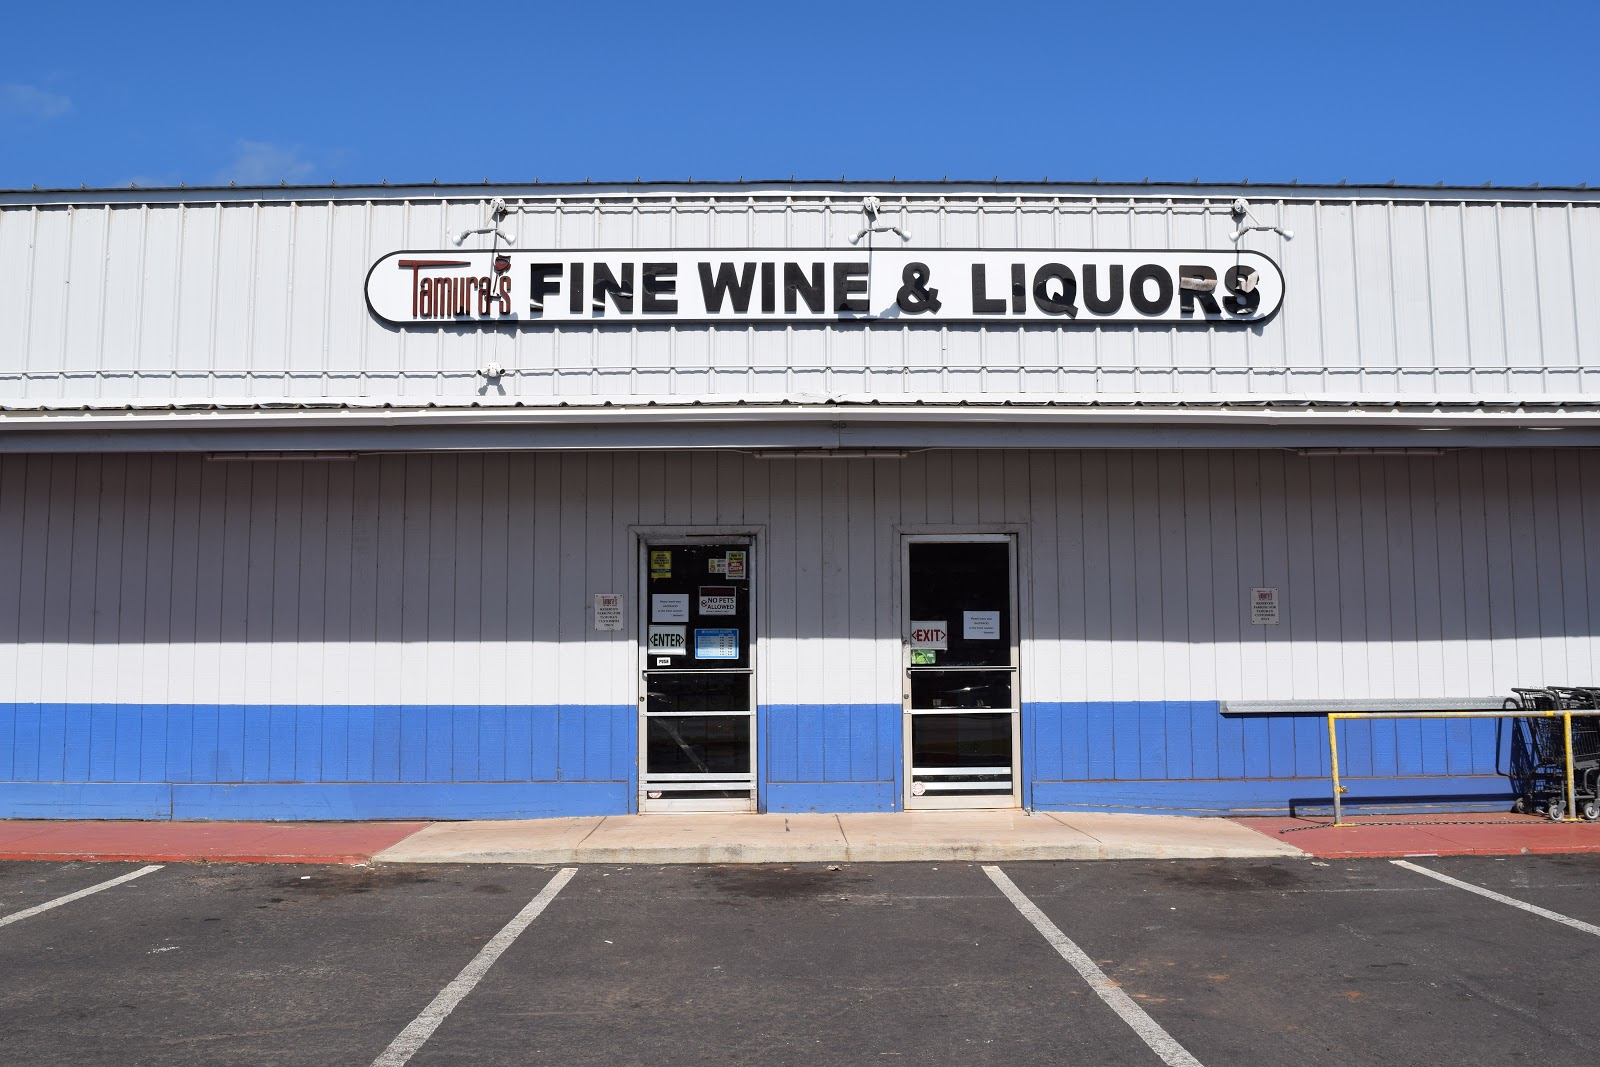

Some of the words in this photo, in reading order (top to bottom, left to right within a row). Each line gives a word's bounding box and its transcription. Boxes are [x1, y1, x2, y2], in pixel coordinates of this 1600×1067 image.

[530, 263, 678, 314] FINE
[698, 262, 870, 314] WINE
[896, 262, 942, 315] &
[971, 263, 1261, 319] LIQUORS
[653, 633, 681, 647] ENTER
[916, 629, 941, 641] EXIT
